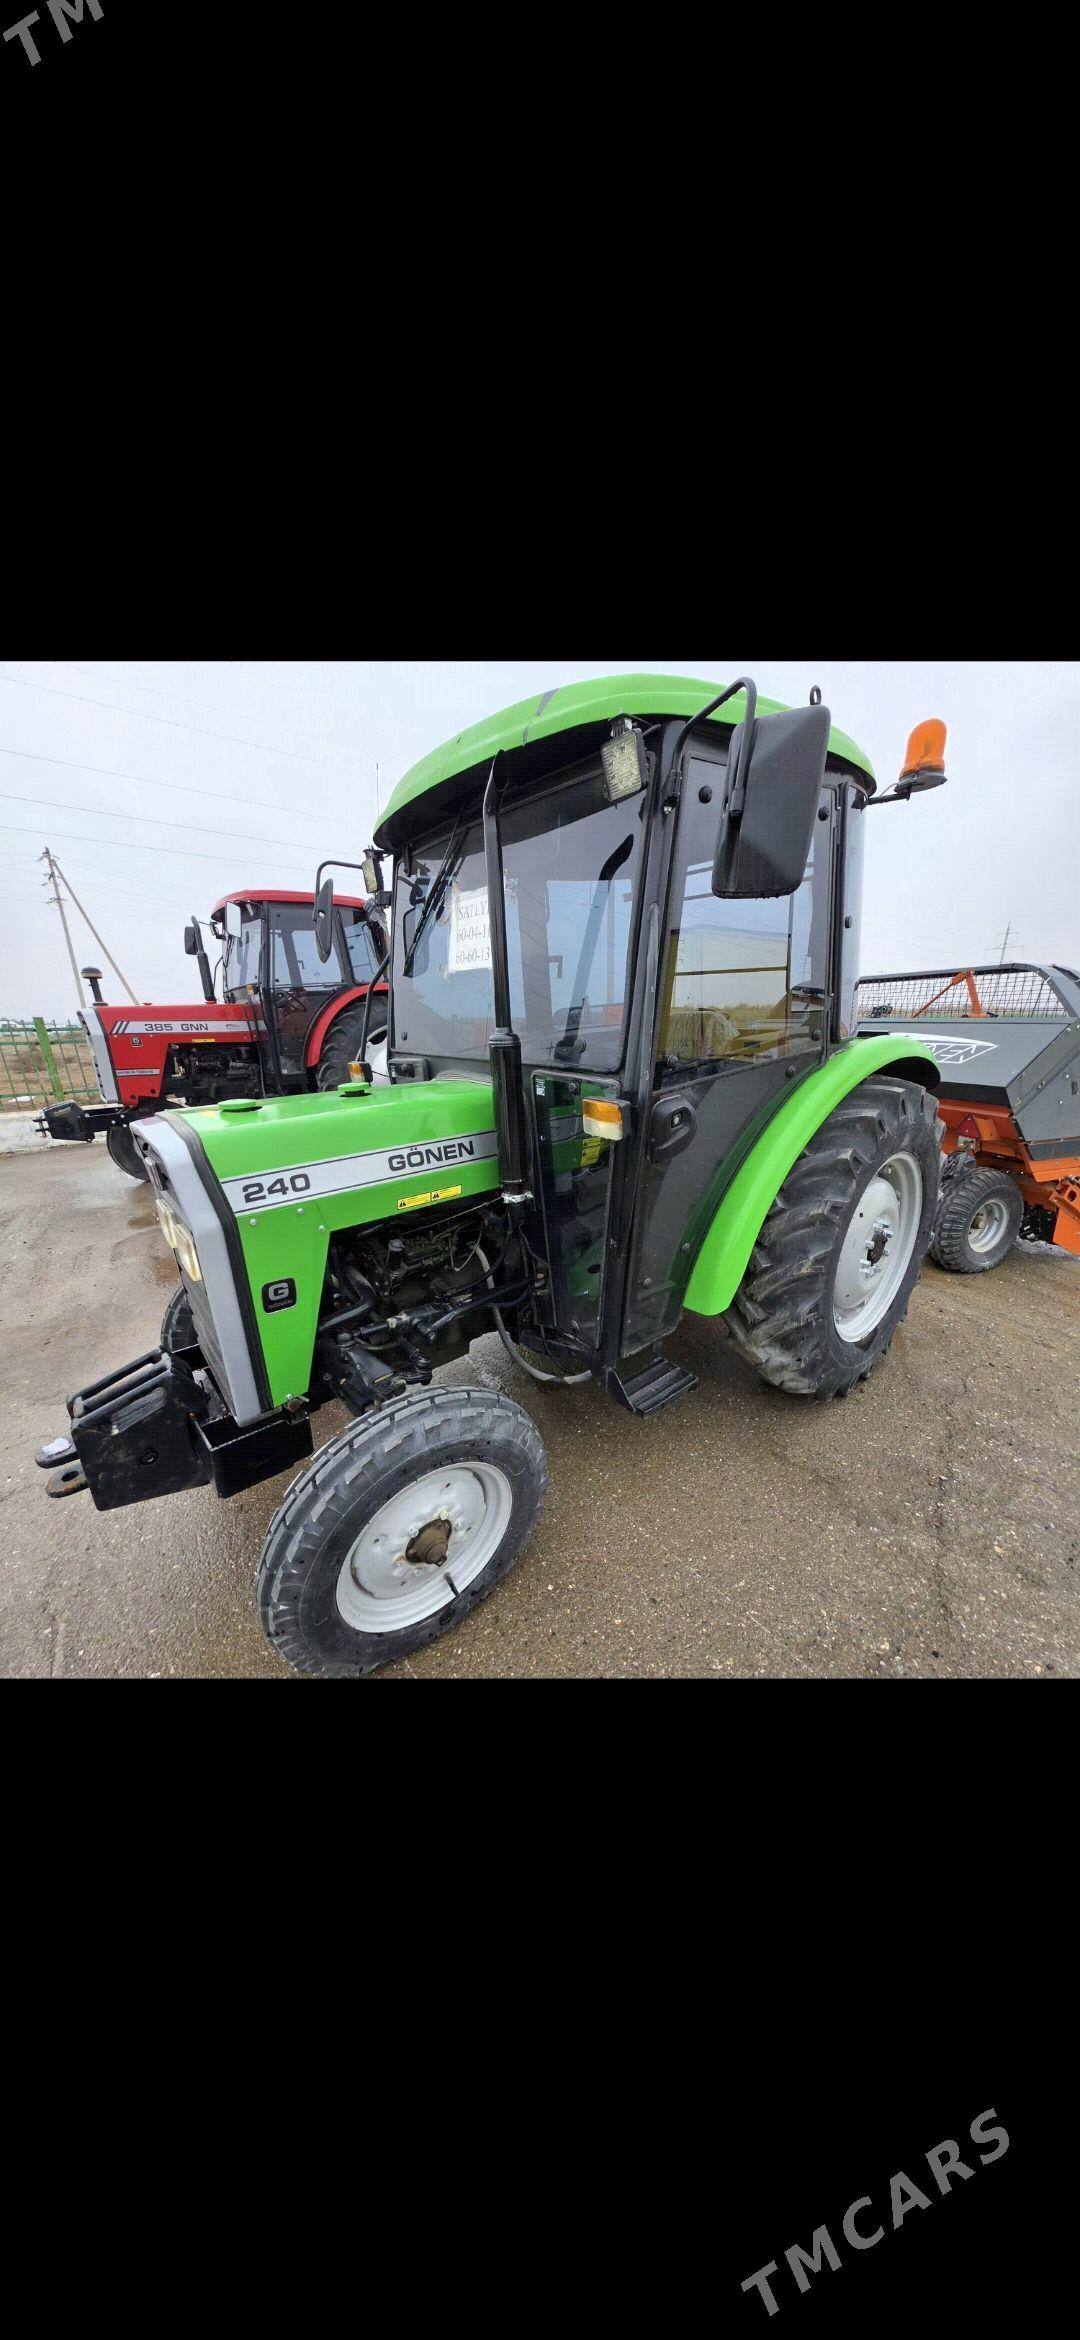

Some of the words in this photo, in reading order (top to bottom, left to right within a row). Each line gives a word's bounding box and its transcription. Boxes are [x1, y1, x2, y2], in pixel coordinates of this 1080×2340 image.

[458, 899, 489, 920] SATLY
[144, 1023, 173, 1032] 385
[181, 1023, 208, 1032] GNN
[242, 1173, 311, 1204] 240
[388, 1140, 475, 1172] GÖNEN
[268, 1282, 290, 1301] G
